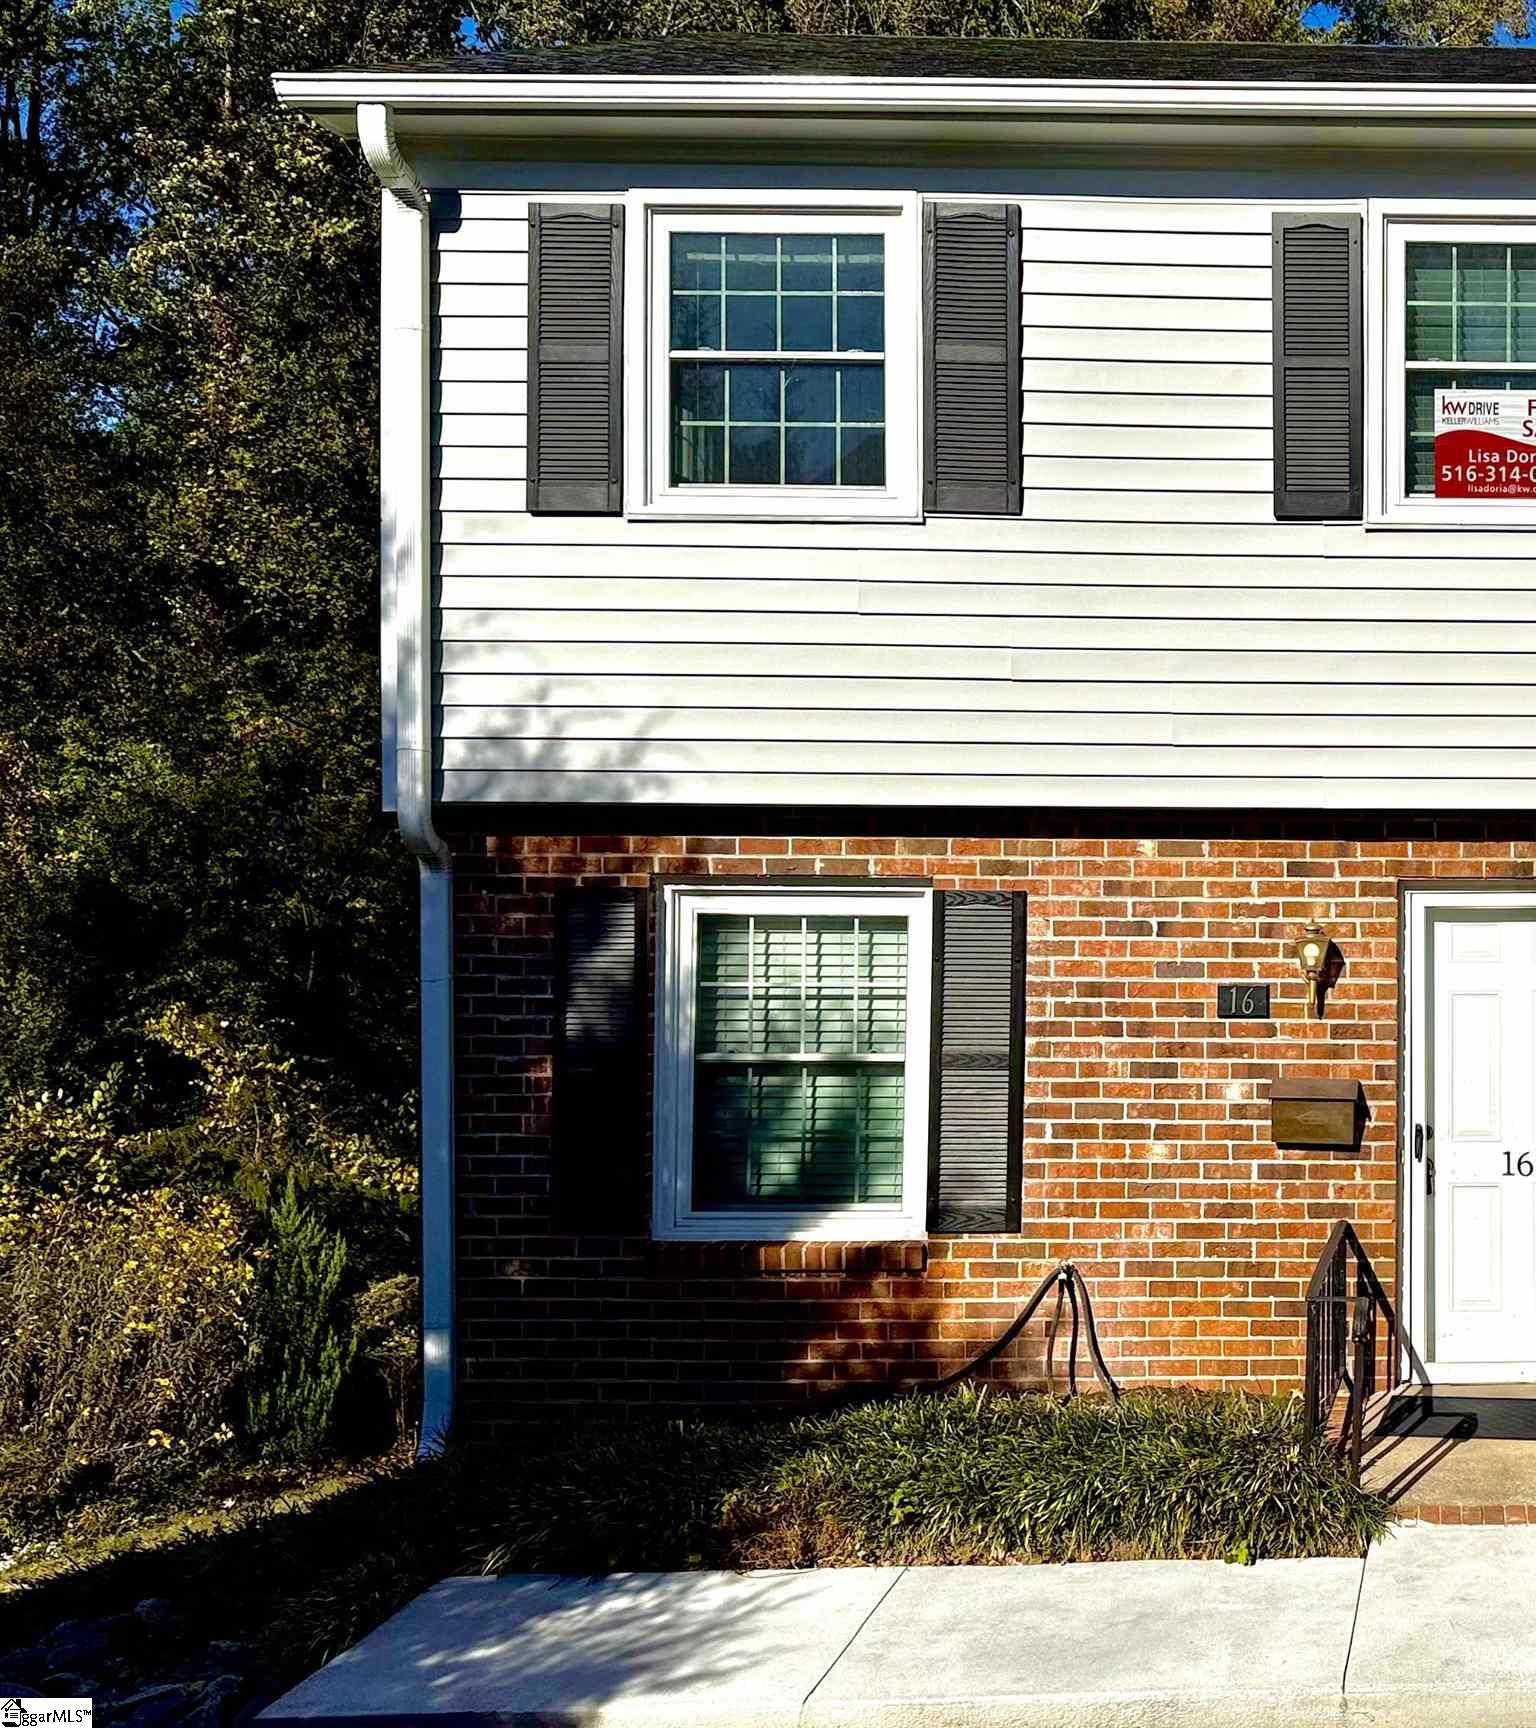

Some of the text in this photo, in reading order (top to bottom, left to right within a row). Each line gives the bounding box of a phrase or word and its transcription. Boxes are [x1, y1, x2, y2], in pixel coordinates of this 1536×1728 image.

[1468, 449, 1500, 463] Lisa
[1230, 986, 1254, 1015] 16
[1502, 1151, 1534, 1177] 16
